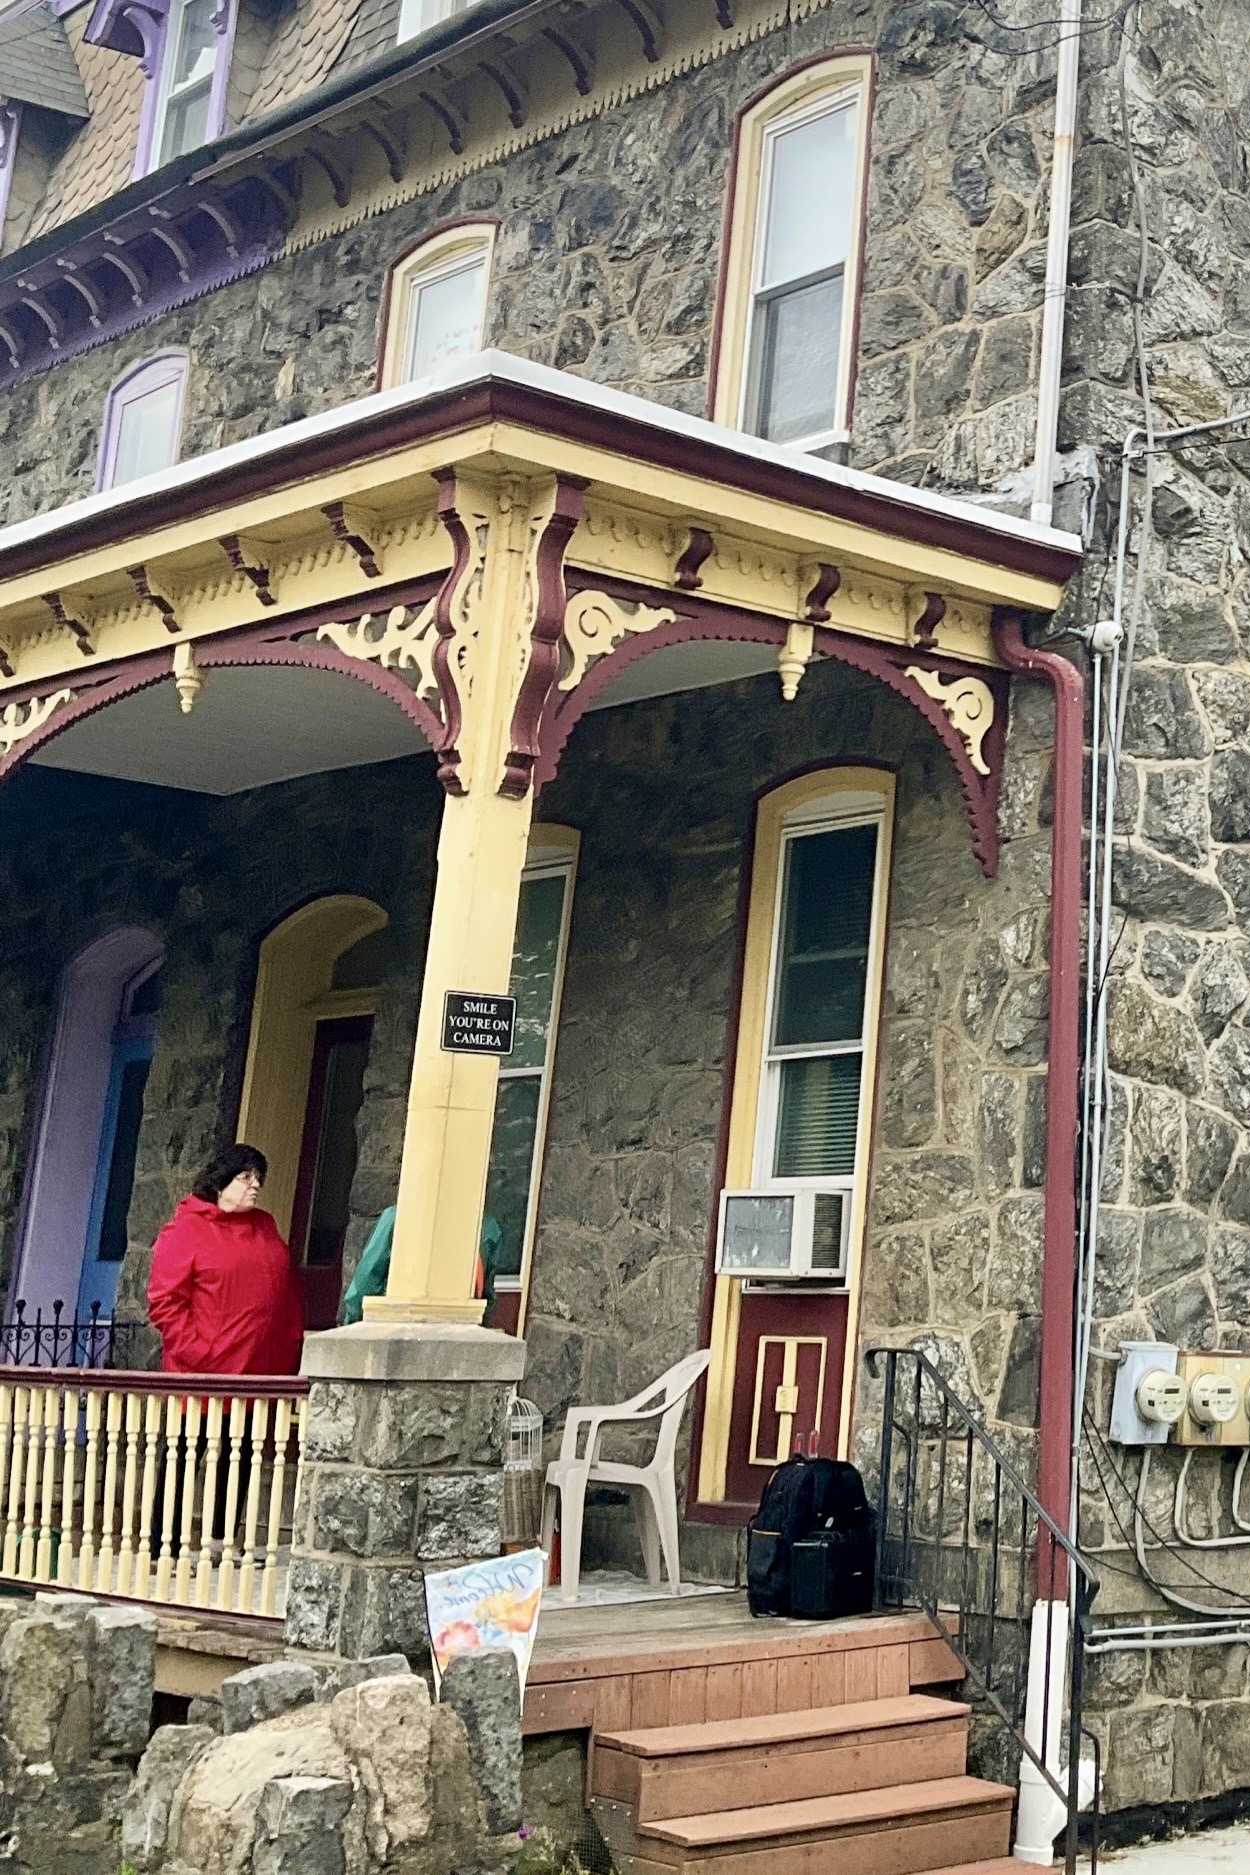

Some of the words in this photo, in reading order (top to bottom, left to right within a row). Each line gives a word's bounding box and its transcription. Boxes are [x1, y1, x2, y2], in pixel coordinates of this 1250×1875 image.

[463, 1001, 498, 1015] SMILE
[449, 1015, 491, 1030] YOU'RE
[492, 1019, 509, 1031] ON
[453, 1031, 501, 1046] CAMERA
